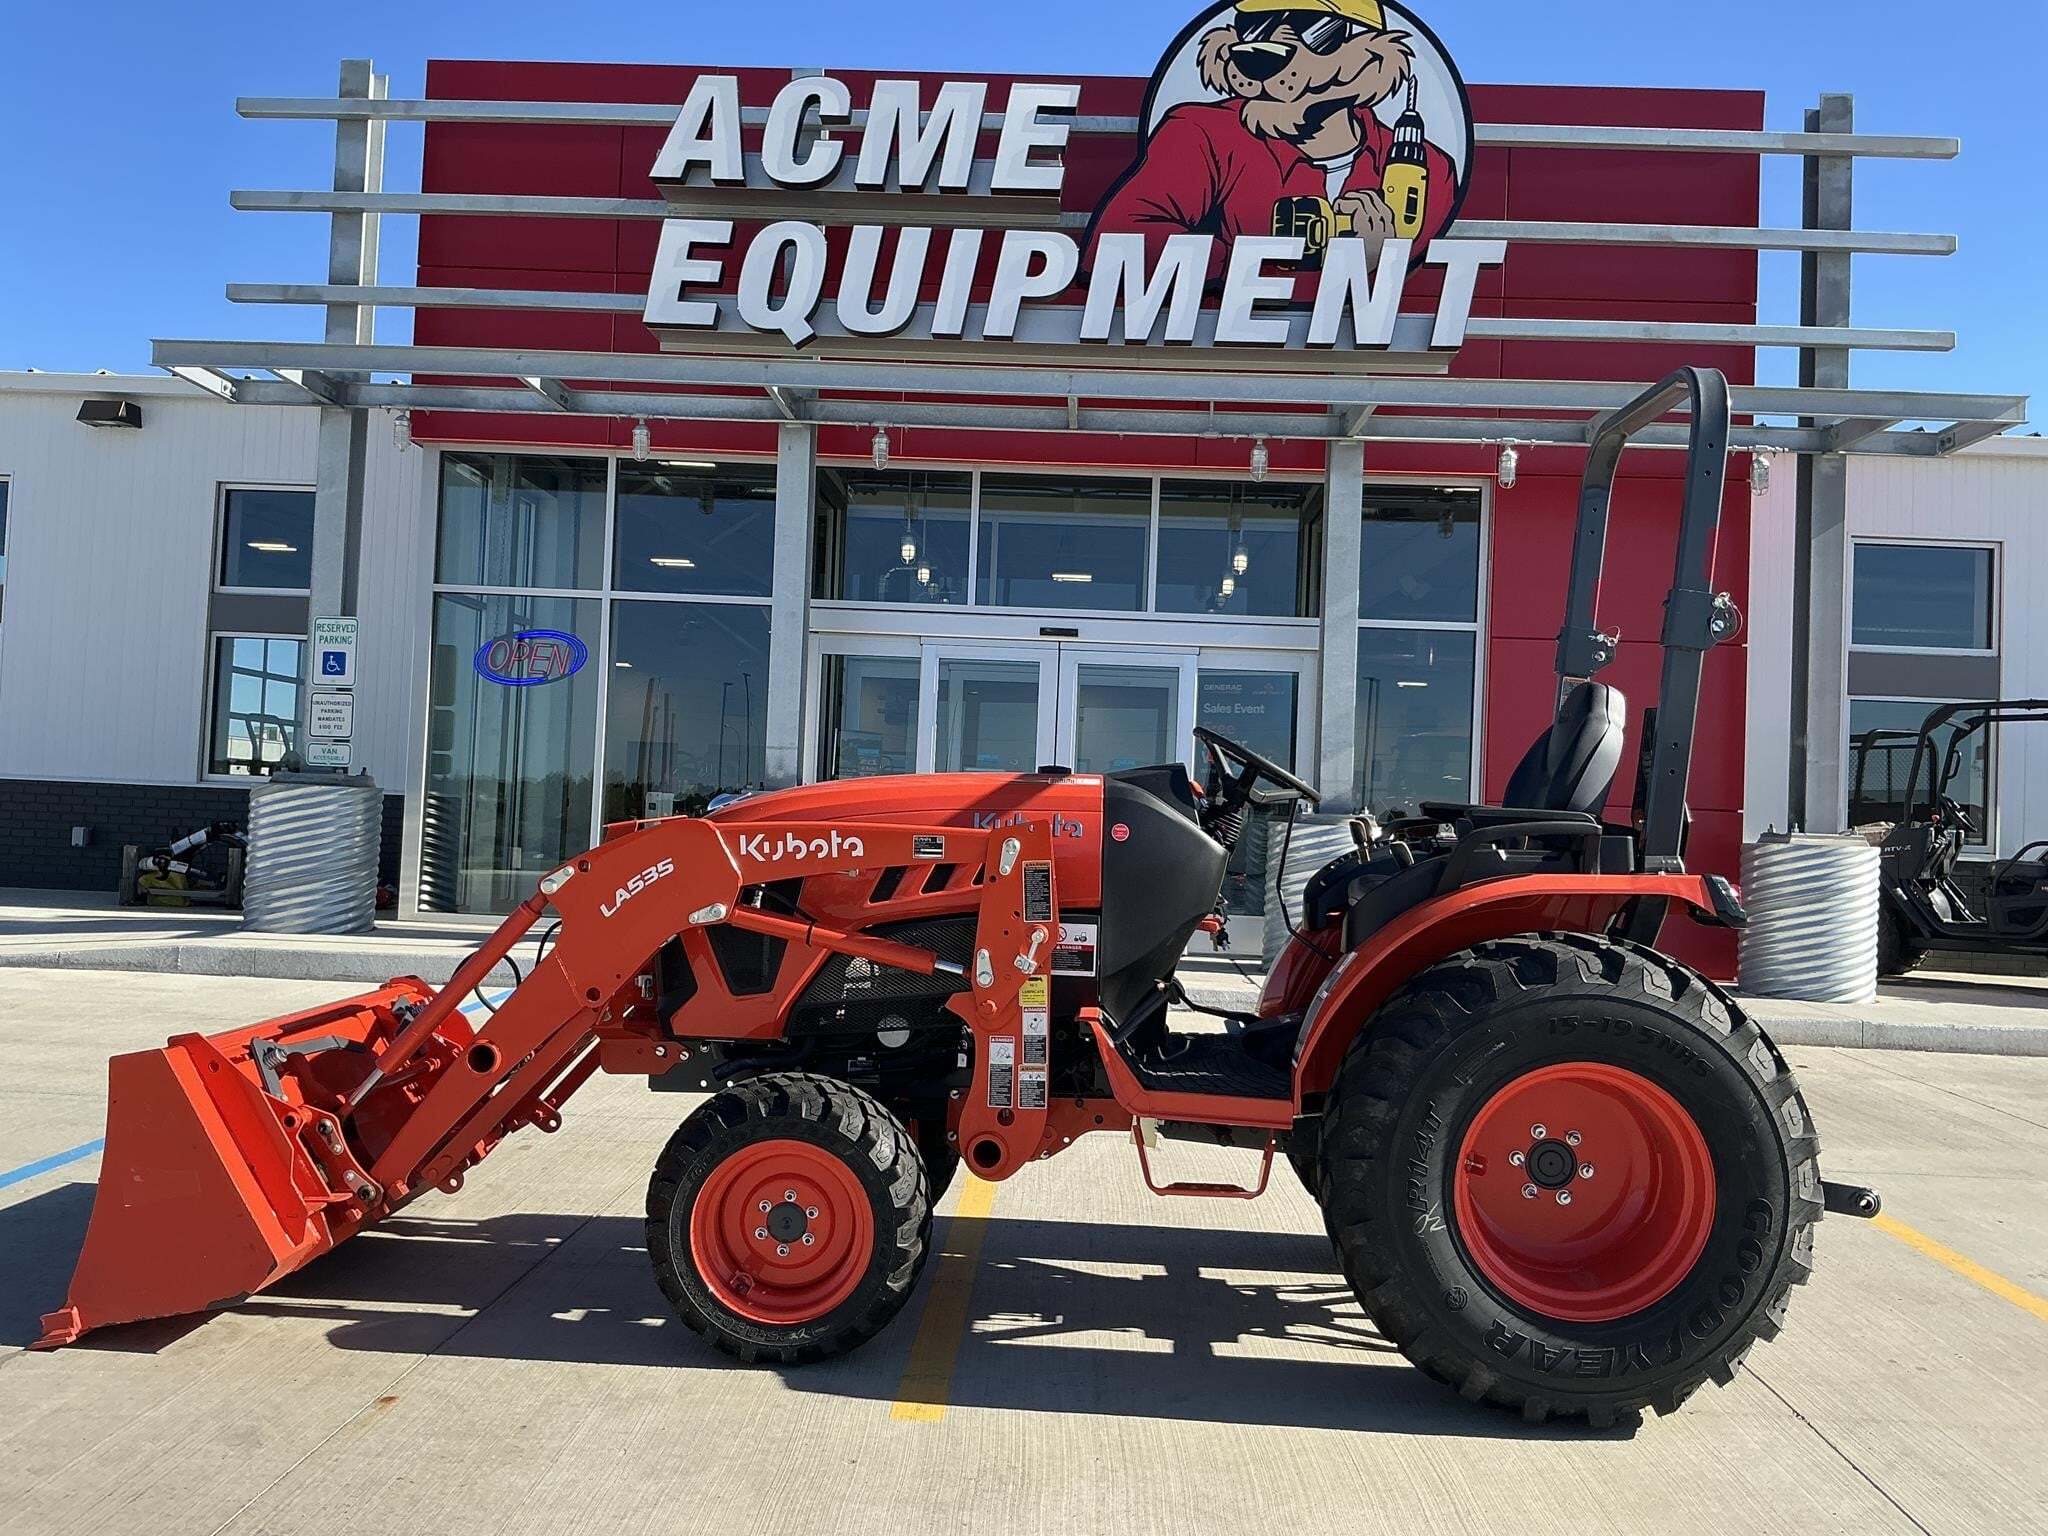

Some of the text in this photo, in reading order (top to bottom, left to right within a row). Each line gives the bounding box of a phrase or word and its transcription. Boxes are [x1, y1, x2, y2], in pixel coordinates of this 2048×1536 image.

[650, 75, 1080, 192] ACME
[642, 218, 1508, 350] EQUIPMENT
[316, 623, 357, 634] RESERVED
[318, 635, 353, 645] PARKING
[488, 640, 570, 677] OPEN
[1202, 703, 1265, 714] Sales Event
[739, 829, 864, 862] Kubota
[600, 857, 675, 918] LA535
[1483, 1198, 1776, 1380] GOODYEAR
